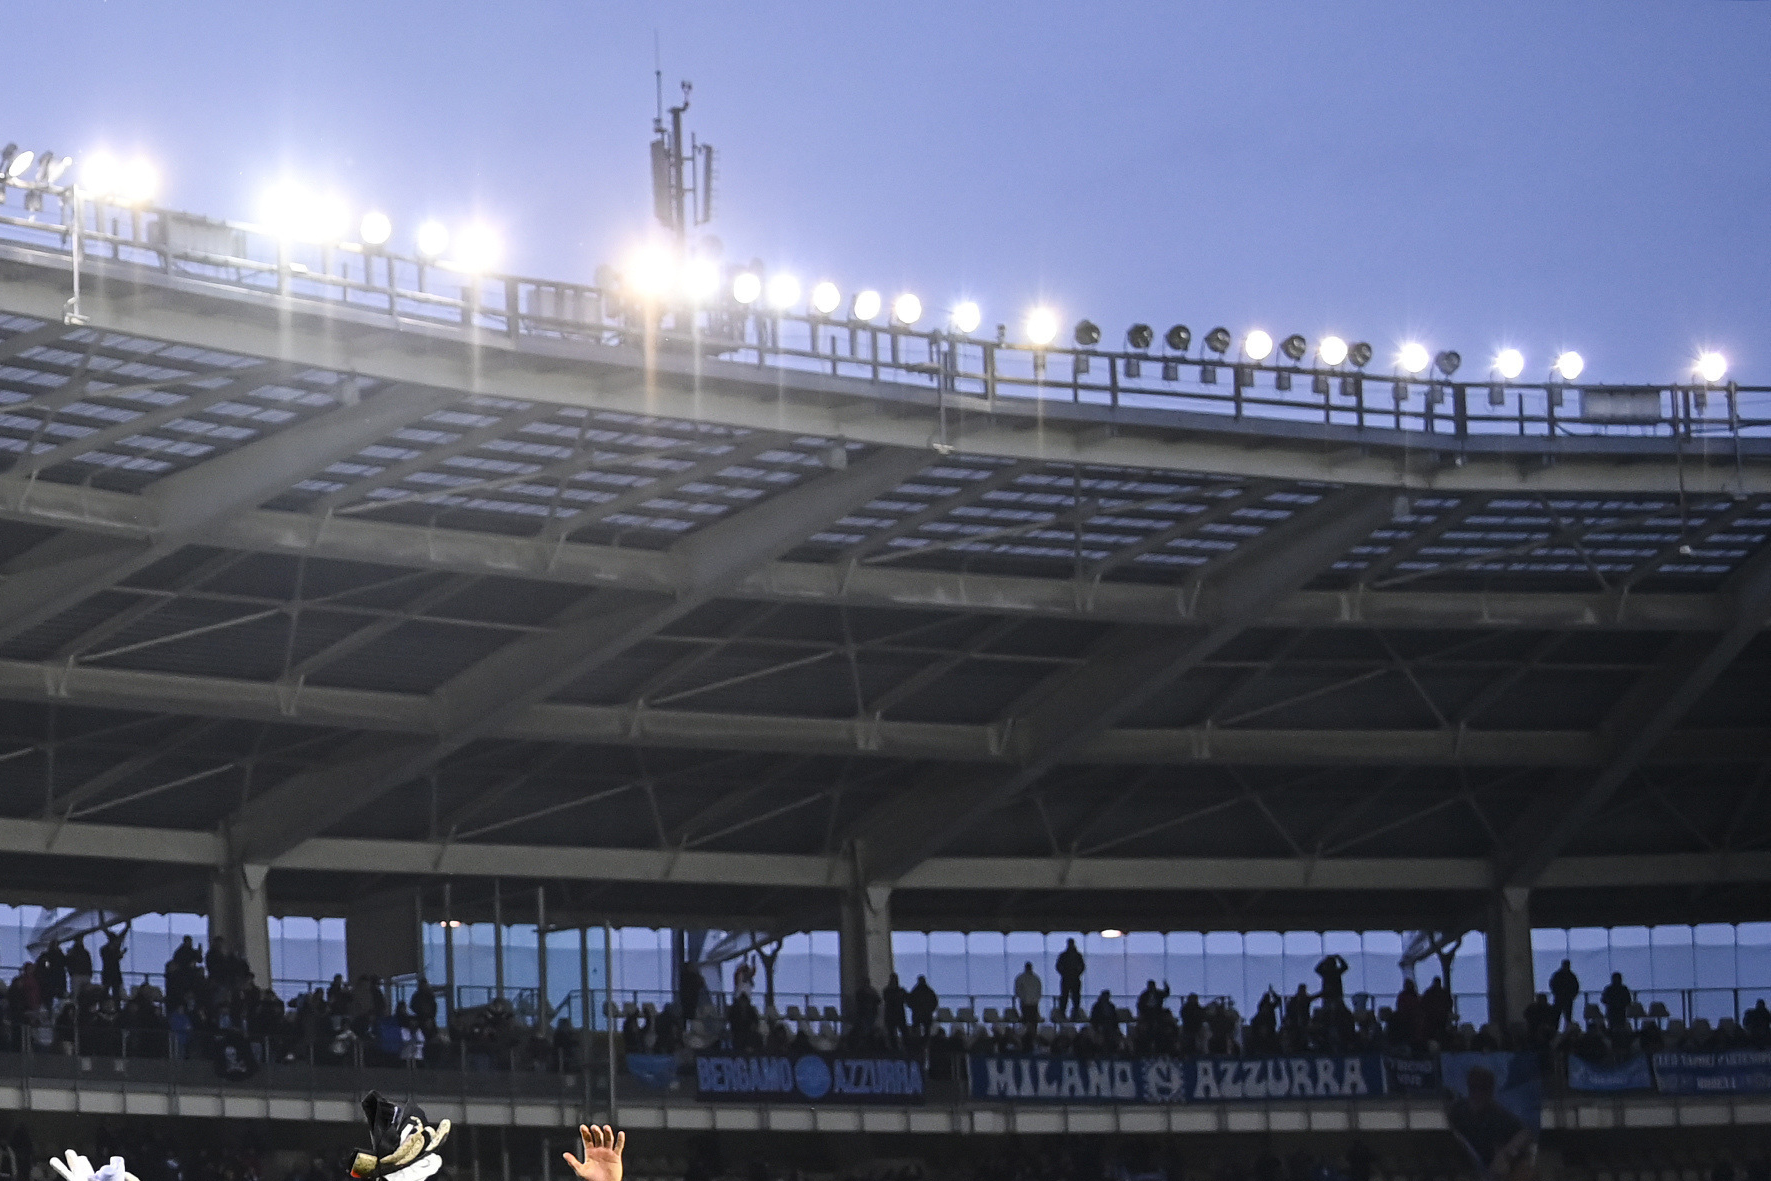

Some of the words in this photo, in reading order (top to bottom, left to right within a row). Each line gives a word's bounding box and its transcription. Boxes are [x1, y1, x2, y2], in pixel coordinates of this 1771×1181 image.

[696, 1056, 793, 1092] BERGAMO
[833, 1058, 923, 1094] AZZURRA
[986, 1058, 1137, 1096] MILANO
[1193, 1058, 1368, 1098] AZZURRA
